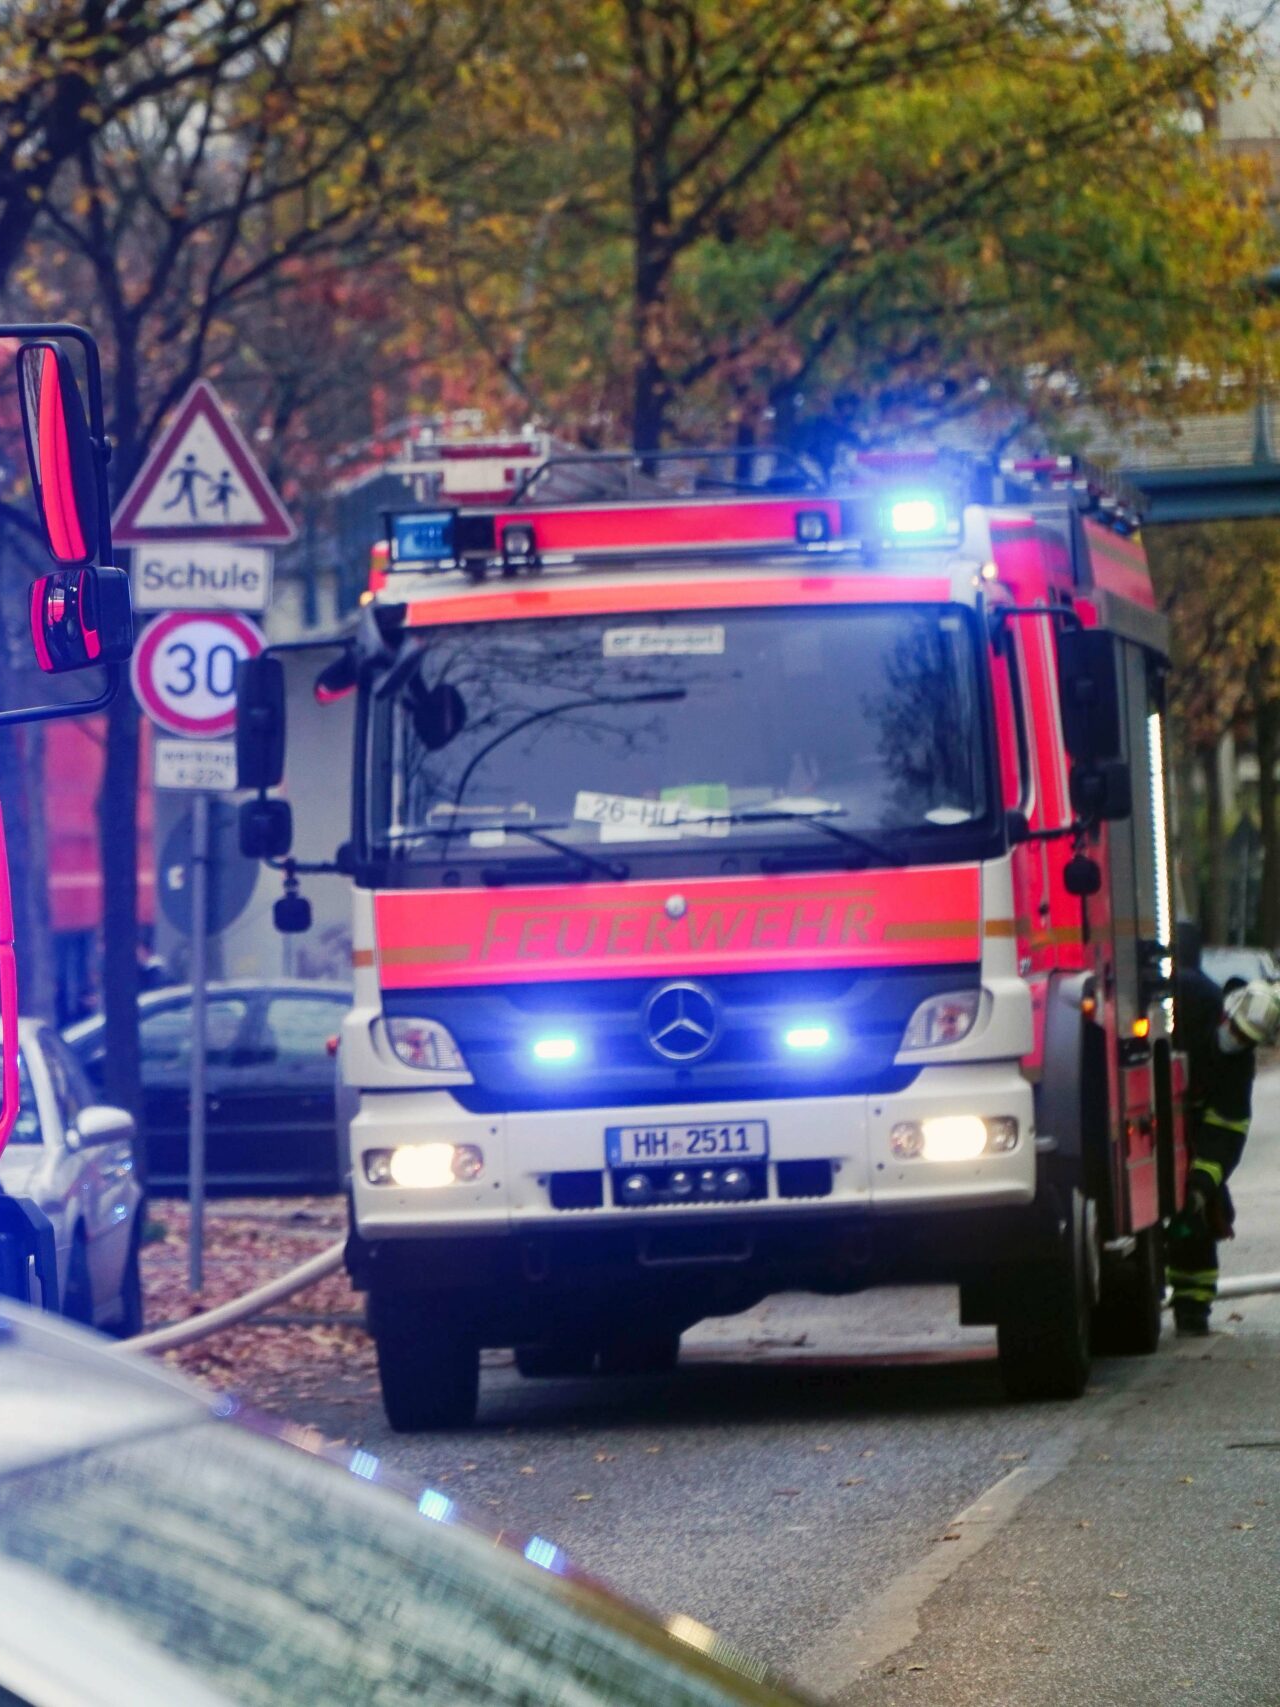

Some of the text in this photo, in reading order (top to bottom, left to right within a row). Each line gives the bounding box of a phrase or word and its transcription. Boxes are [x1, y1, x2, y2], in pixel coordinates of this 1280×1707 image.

[143, 561, 260, 591] Schule
[166, 642, 238, 697] 30
[479, 898, 877, 962] FEUERWEHR
[633, 1126, 750, 1157] HH 2511
